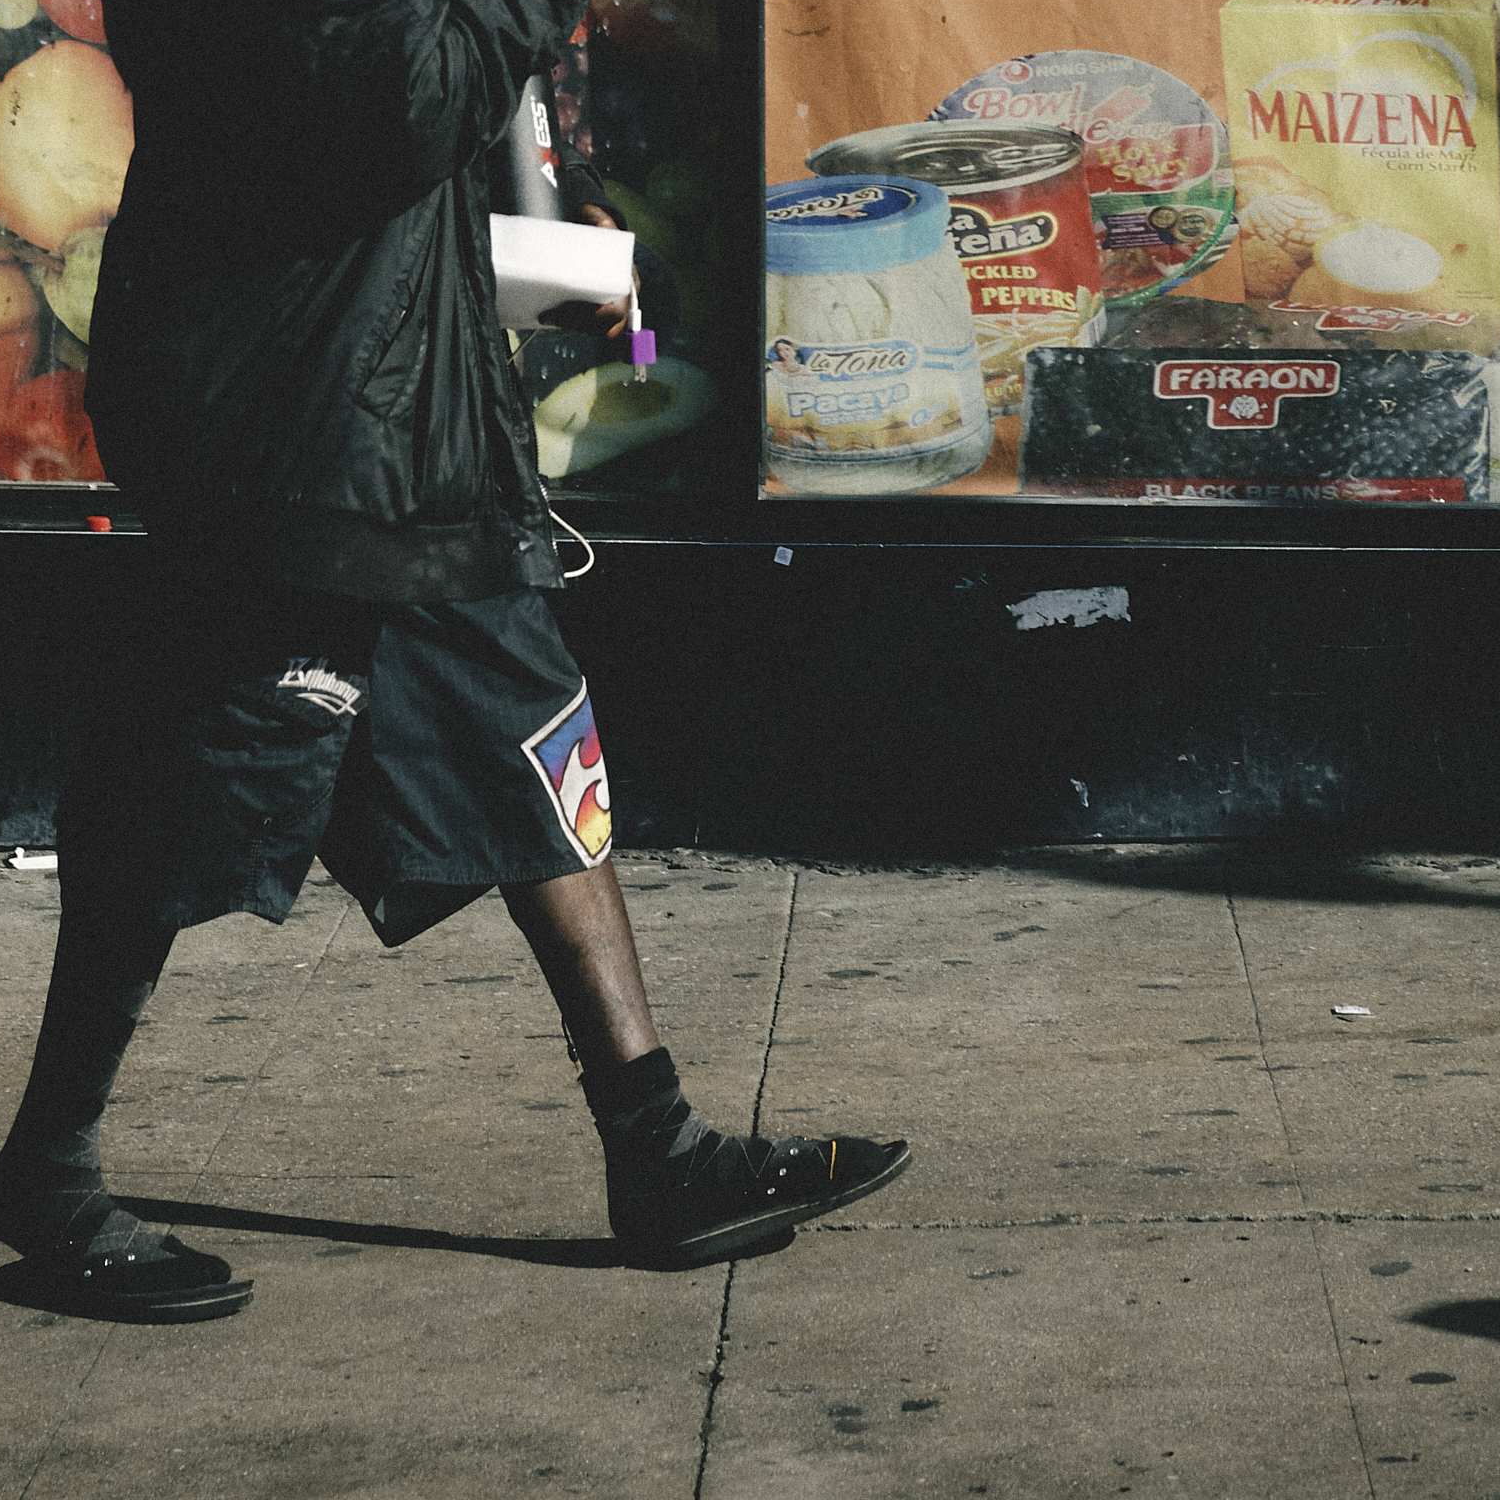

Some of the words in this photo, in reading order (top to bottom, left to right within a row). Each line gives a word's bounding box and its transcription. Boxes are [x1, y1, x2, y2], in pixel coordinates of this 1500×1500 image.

[963, 81, 1087, 121] Bowl
[1245, 88, 1476, 148] MAIZENA
[1362, 146, 1416, 160] Fécula
[1418, 148, 1434, 160] de
[1111, 157, 1192, 186] Spicy
[1386, 159, 1424, 172] Corn
[1429, 161, 1478, 174] Starch
[946, 213, 977, 231] a
[946, 221, 1045, 256] teña
[962, 265, 1038, 281] ICKLED
[980, 285, 1077, 311] PEPPERS
[787, 382, 911, 419] Pacaya
[1144, 483, 1238, 501] BLACK
[1244, 484, 1339, 501] BEANS
